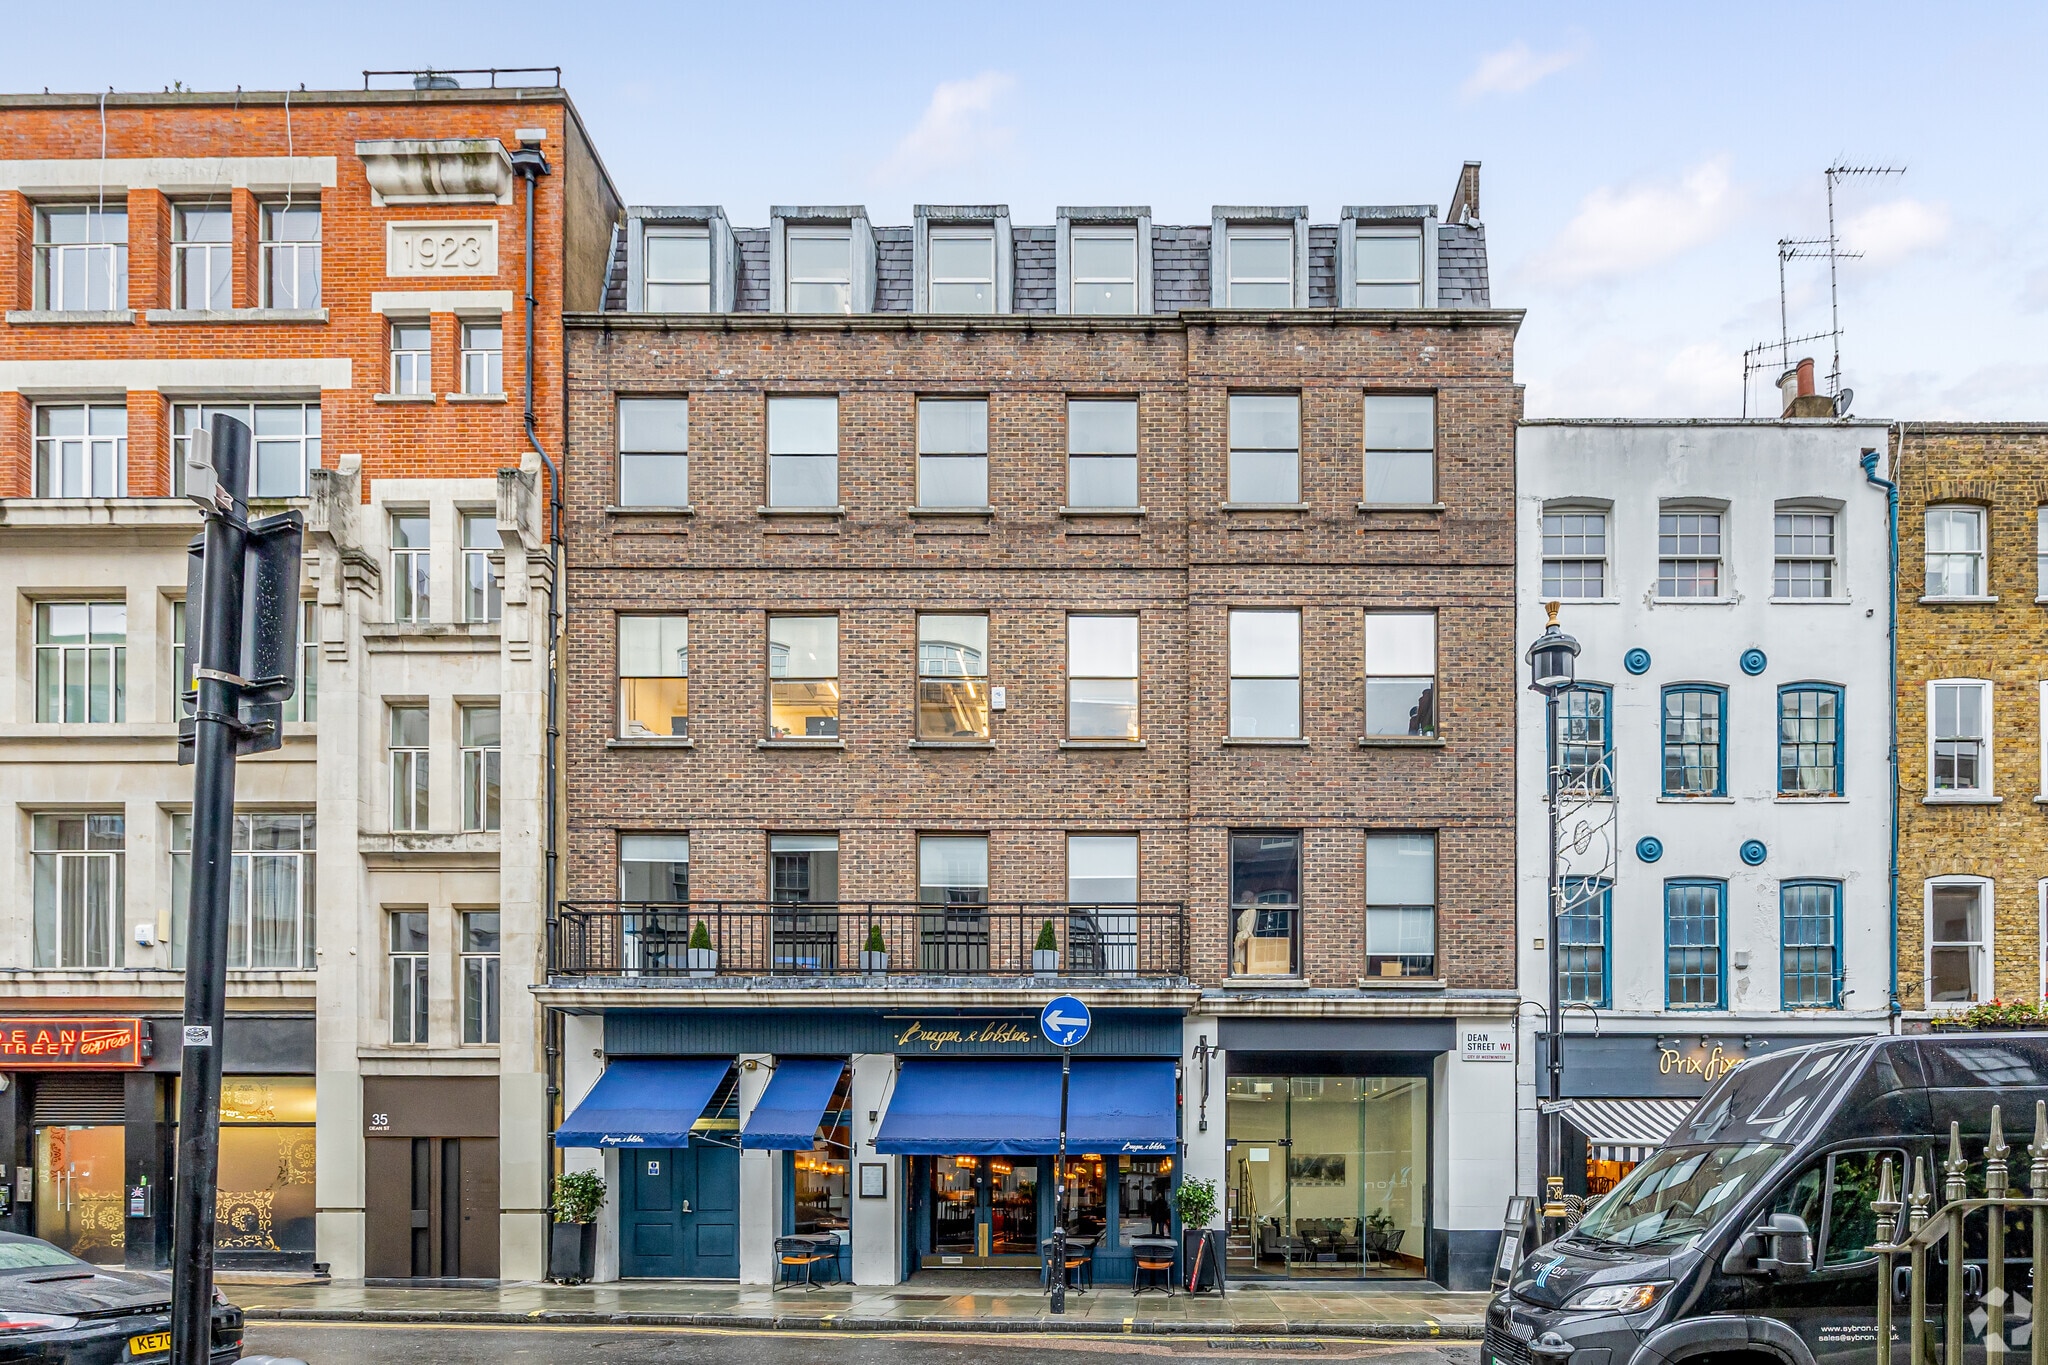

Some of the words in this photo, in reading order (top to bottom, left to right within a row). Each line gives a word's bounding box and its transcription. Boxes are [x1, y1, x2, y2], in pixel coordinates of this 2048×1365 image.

[404, 235, 481, 268] 1923
[0, 1030, 76, 1043] EAN
[0, 1043, 74, 1055] TREET
[80, 1033, 131, 1055] express
[899, 1021, 962, 1050] Burger
[1467, 1033, 1488, 1042] DEAN
[1467, 1042, 1496, 1051] STREET
[1499, 1043, 1511, 1051] W1
[1660, 1048, 1703, 1074] Prix
[372, 1113, 388, 1125] 35
